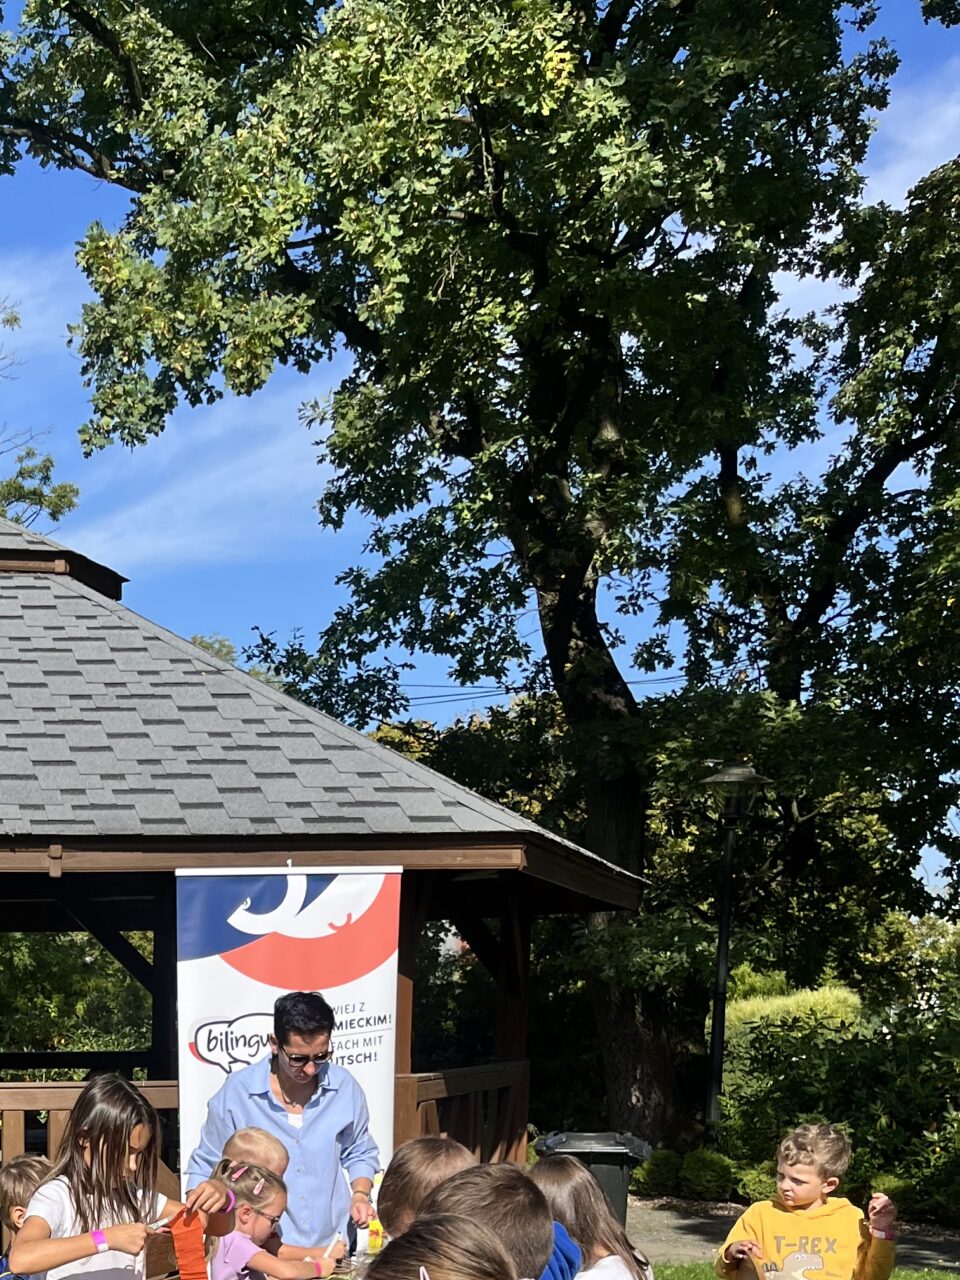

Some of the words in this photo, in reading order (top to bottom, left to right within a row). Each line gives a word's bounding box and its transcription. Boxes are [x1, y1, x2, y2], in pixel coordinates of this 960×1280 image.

[333, 1003, 356, 1015] WIEJ
[359, 1002, 366, 1012] Z
[333, 1013, 392, 1031] MIECKIM!
[207, 1029, 270, 1057] bilingu
[331, 1038, 359, 1051] FACH
[362, 1035, 383, 1047] MIT
[331, 1052, 377, 1066] UTSCH!
[774, 1236, 837, 1254] T-REX
